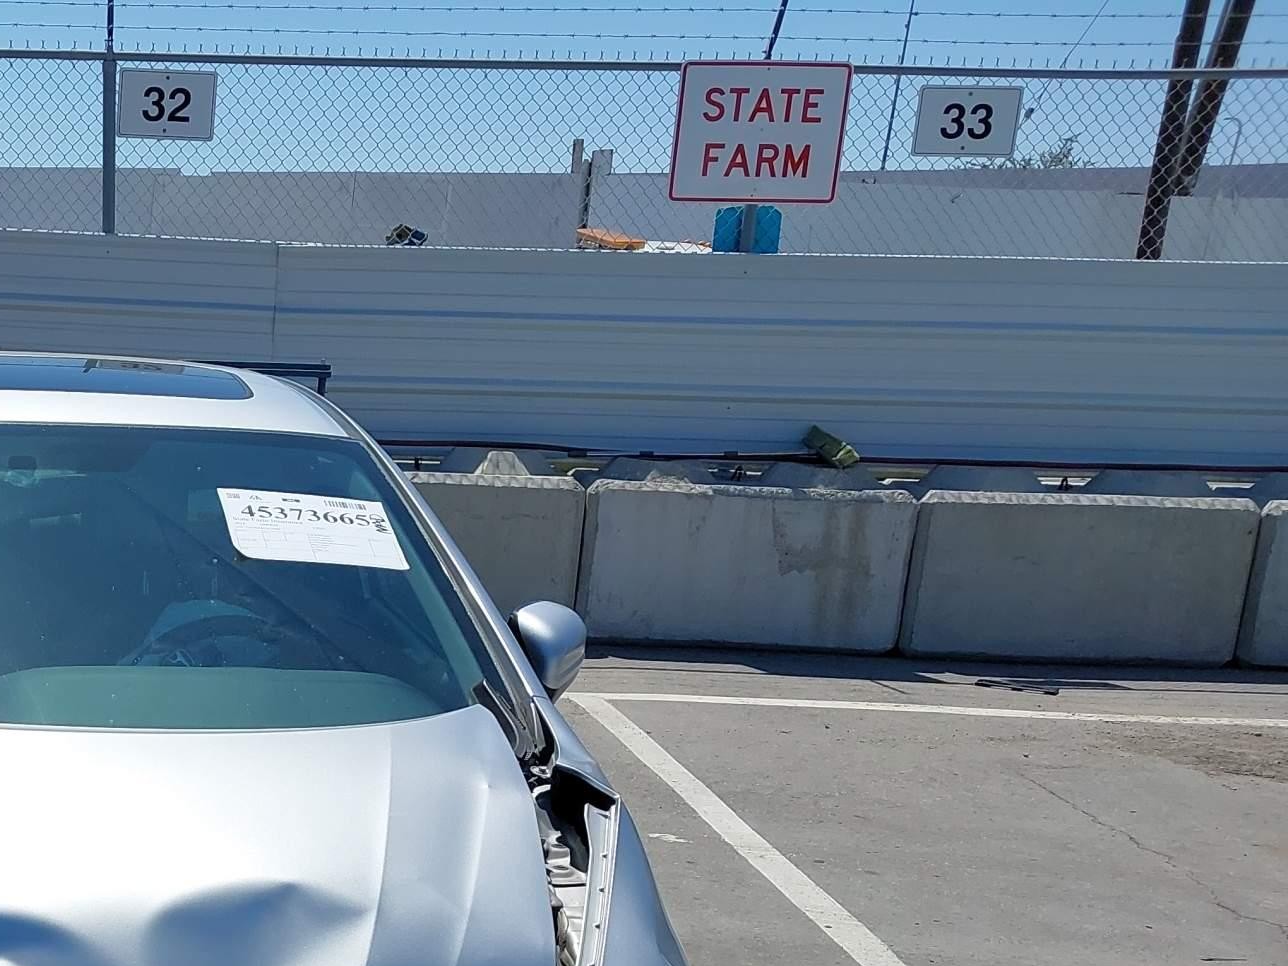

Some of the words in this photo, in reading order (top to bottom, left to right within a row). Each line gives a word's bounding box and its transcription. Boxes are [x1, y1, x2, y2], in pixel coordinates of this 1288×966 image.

[142, 86, 191, 123] 32
[702, 87, 825, 123] STATE
[940, 103, 993, 139] 33
[701, 143, 811, 178] FARM
[241, 504, 370, 527] 45373665
